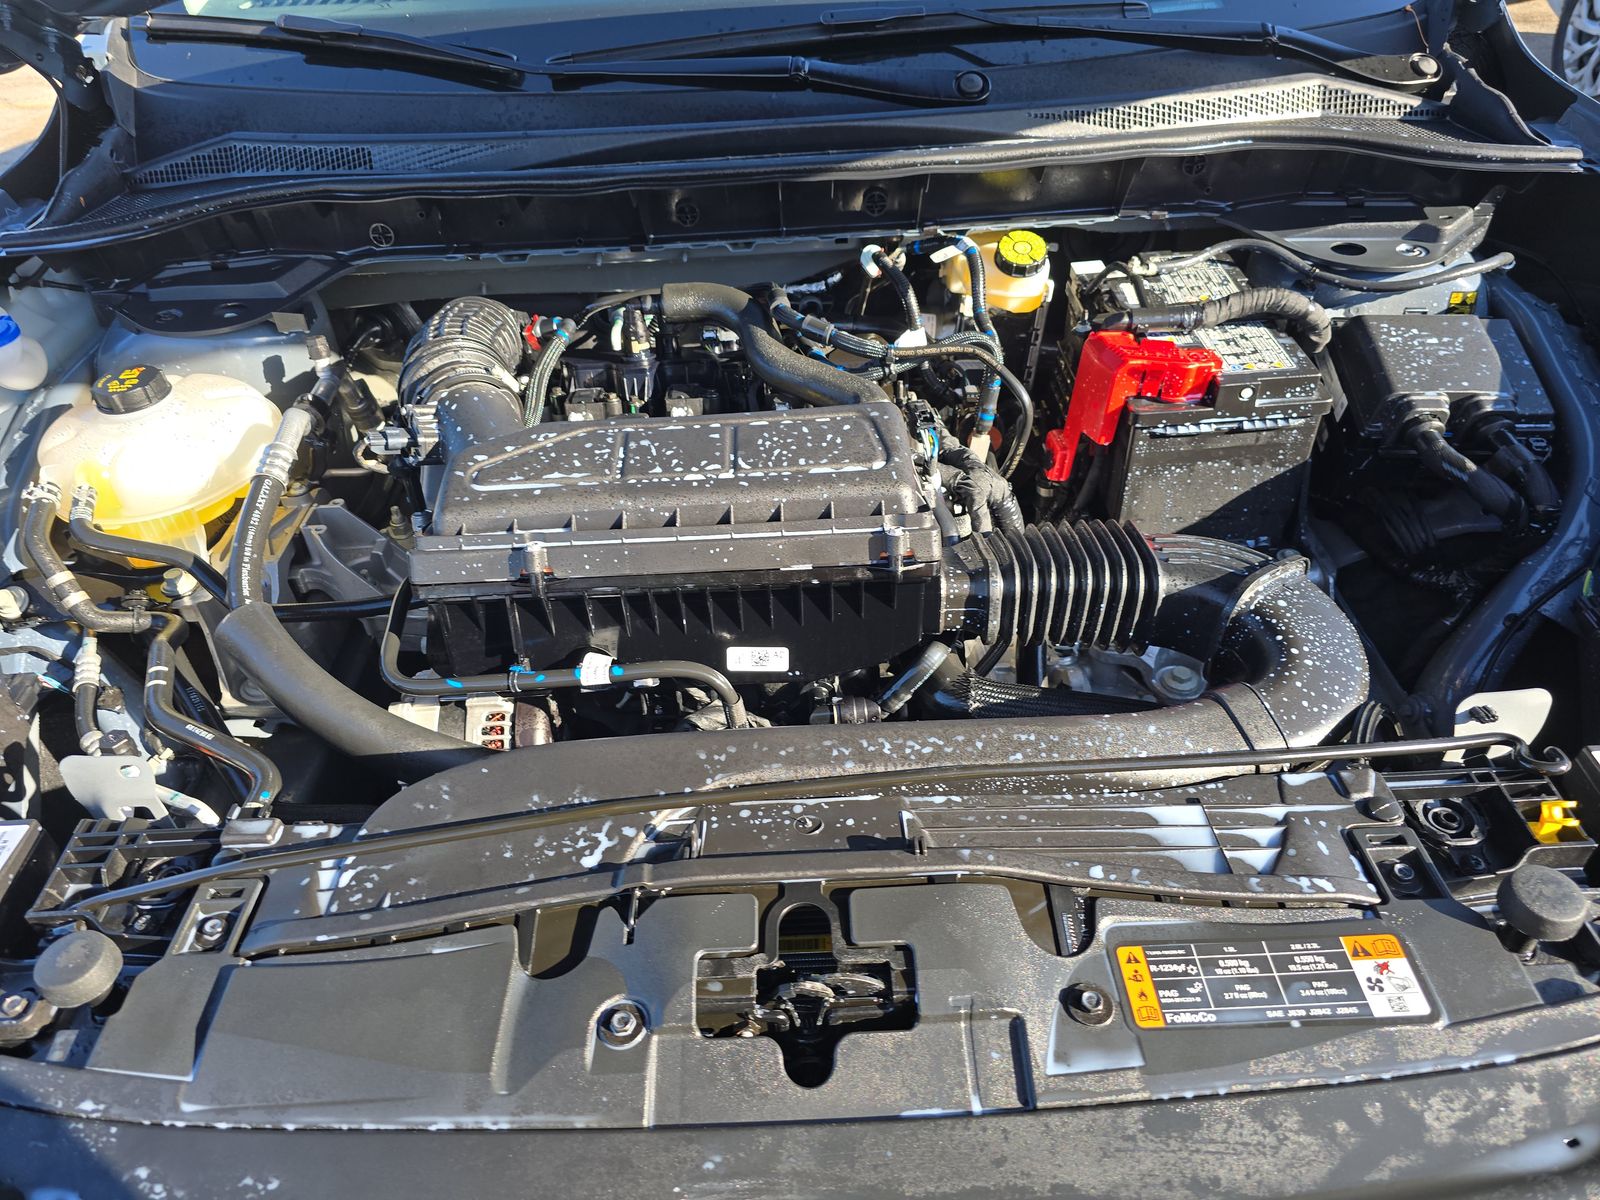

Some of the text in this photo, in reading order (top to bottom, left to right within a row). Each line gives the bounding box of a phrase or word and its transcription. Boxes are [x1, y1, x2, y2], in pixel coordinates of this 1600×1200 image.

[256, 479, 272, 510] GALAXY
[1238, 959, 1250, 968] kg
[1314, 955, 1326, 963] kg
[1149, 963, 1186, 973] R-1234yf
[1158, 989, 1179, 998] PAG
[1165, 1012, 1217, 1024] FoMoCo
[1266, 1009, 1285, 1018] SAE
